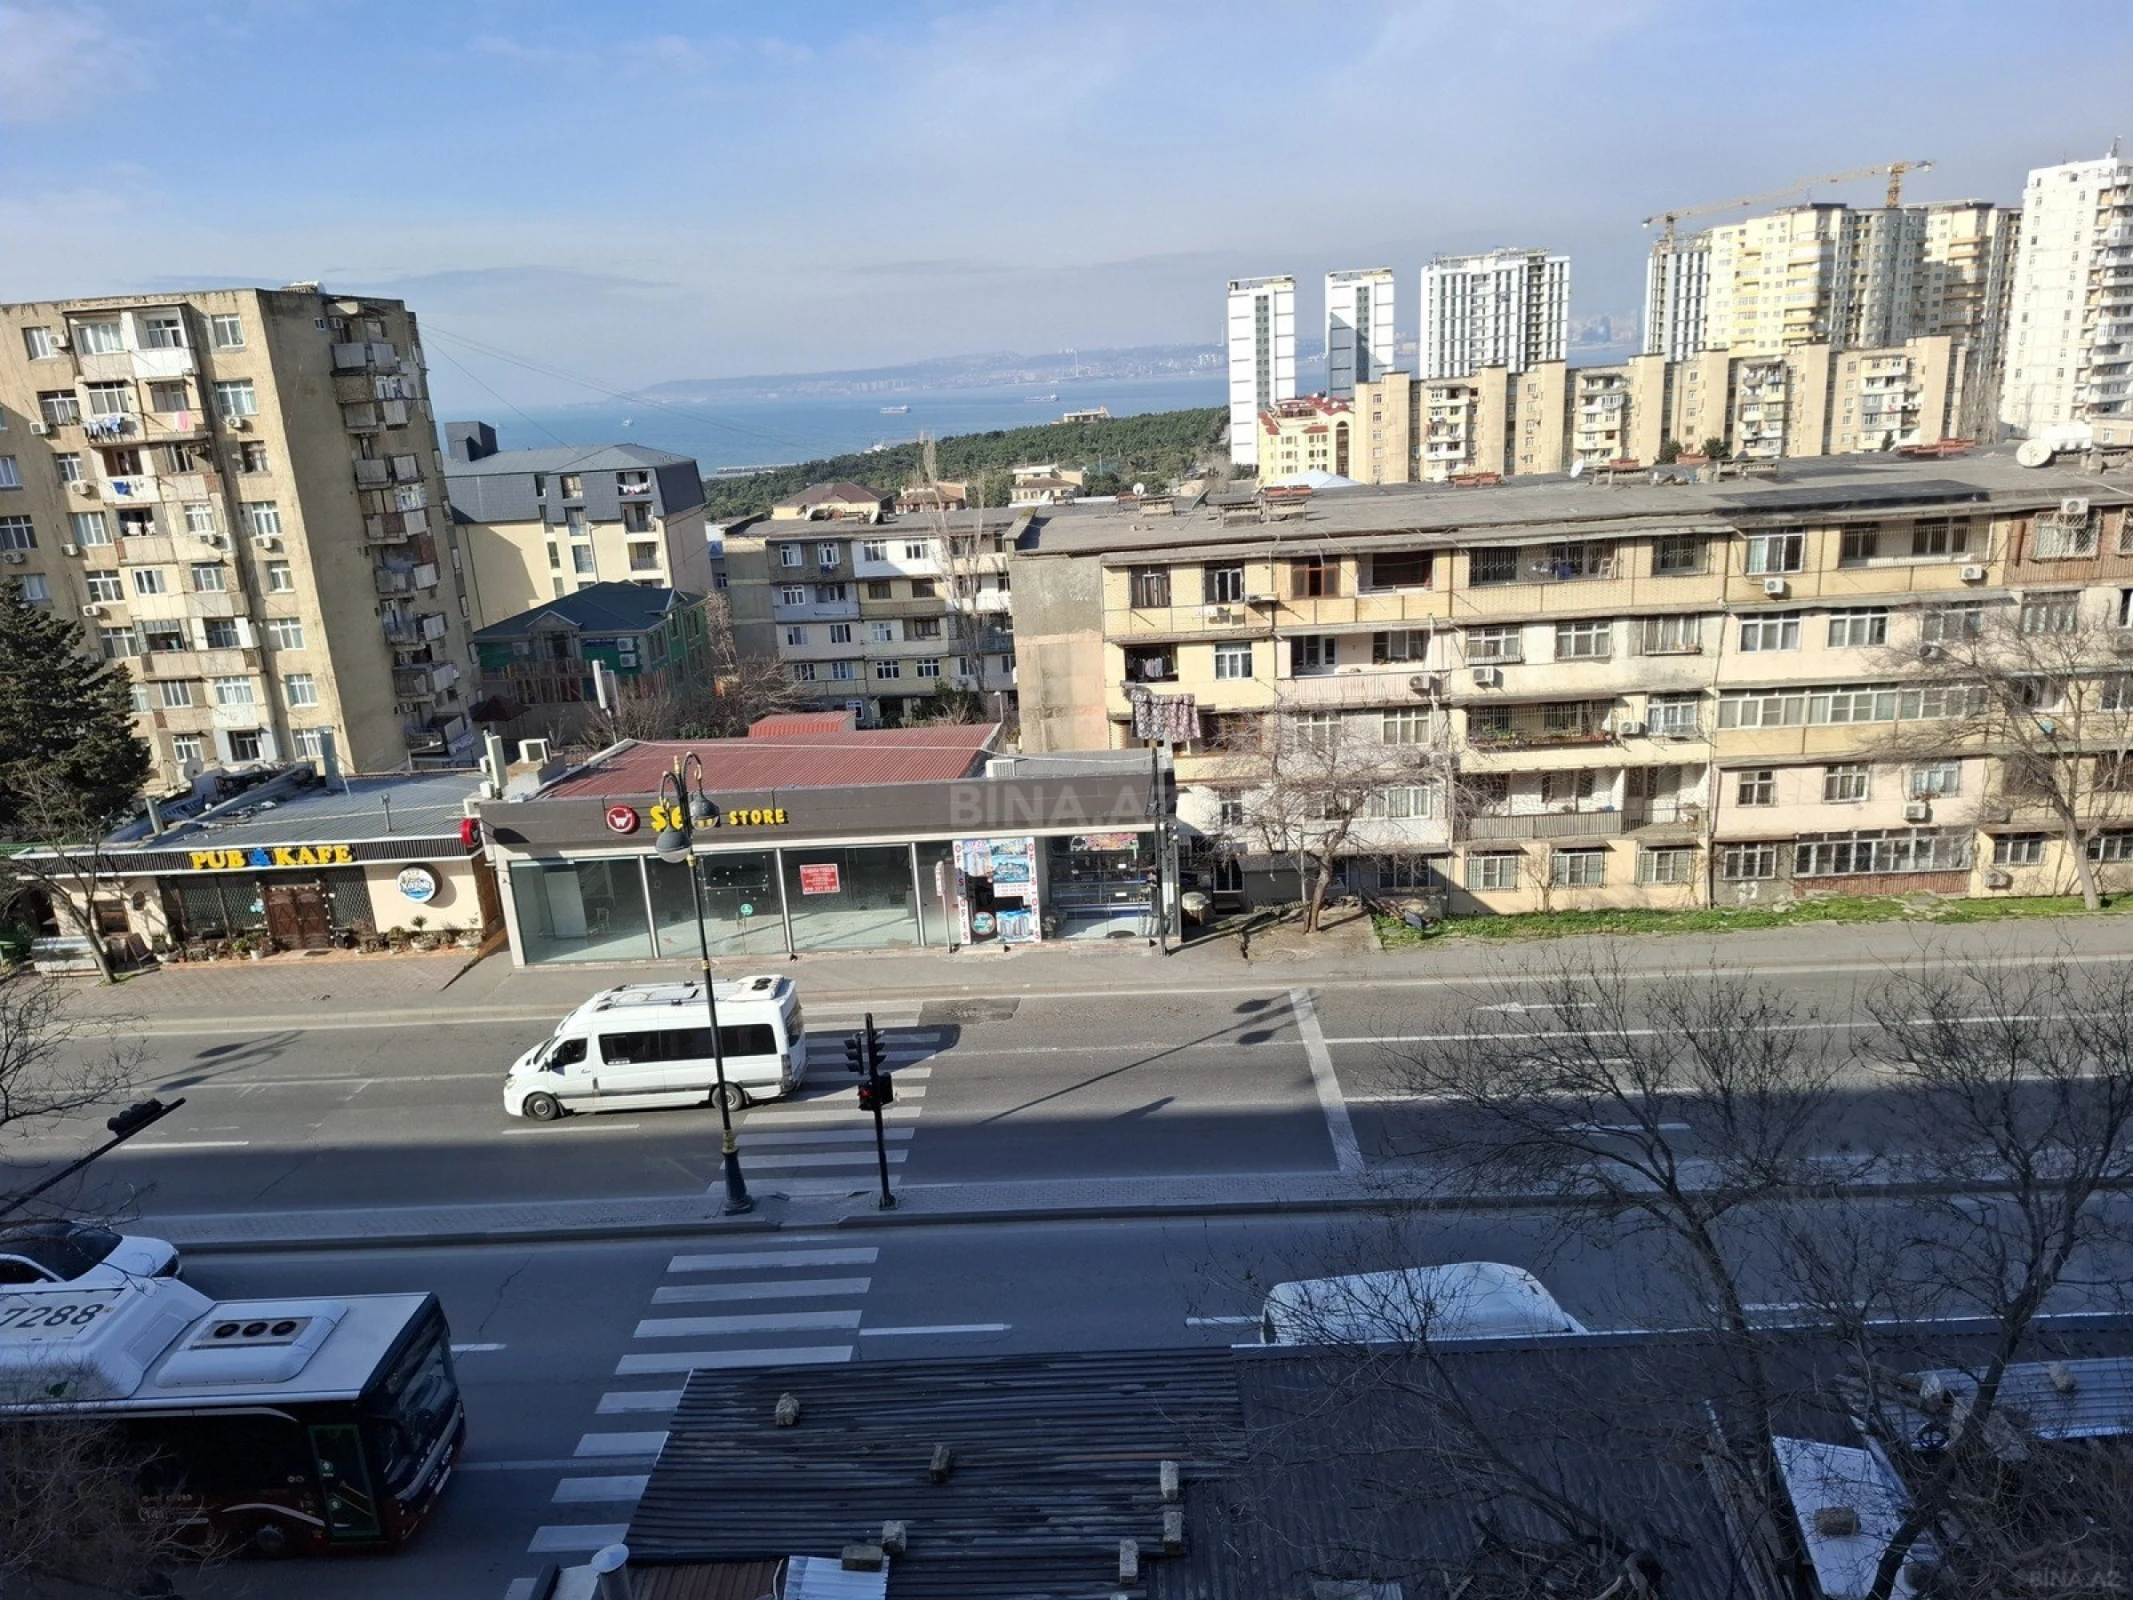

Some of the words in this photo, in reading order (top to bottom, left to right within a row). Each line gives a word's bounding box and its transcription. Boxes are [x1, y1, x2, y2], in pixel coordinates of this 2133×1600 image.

[728, 808, 785, 825] STORE
[189, 849, 246, 870] PUB
[248, 847, 272, 867] &
[273, 844, 353, 866] KAFE
[0, 1303, 105, 1329] 7288
